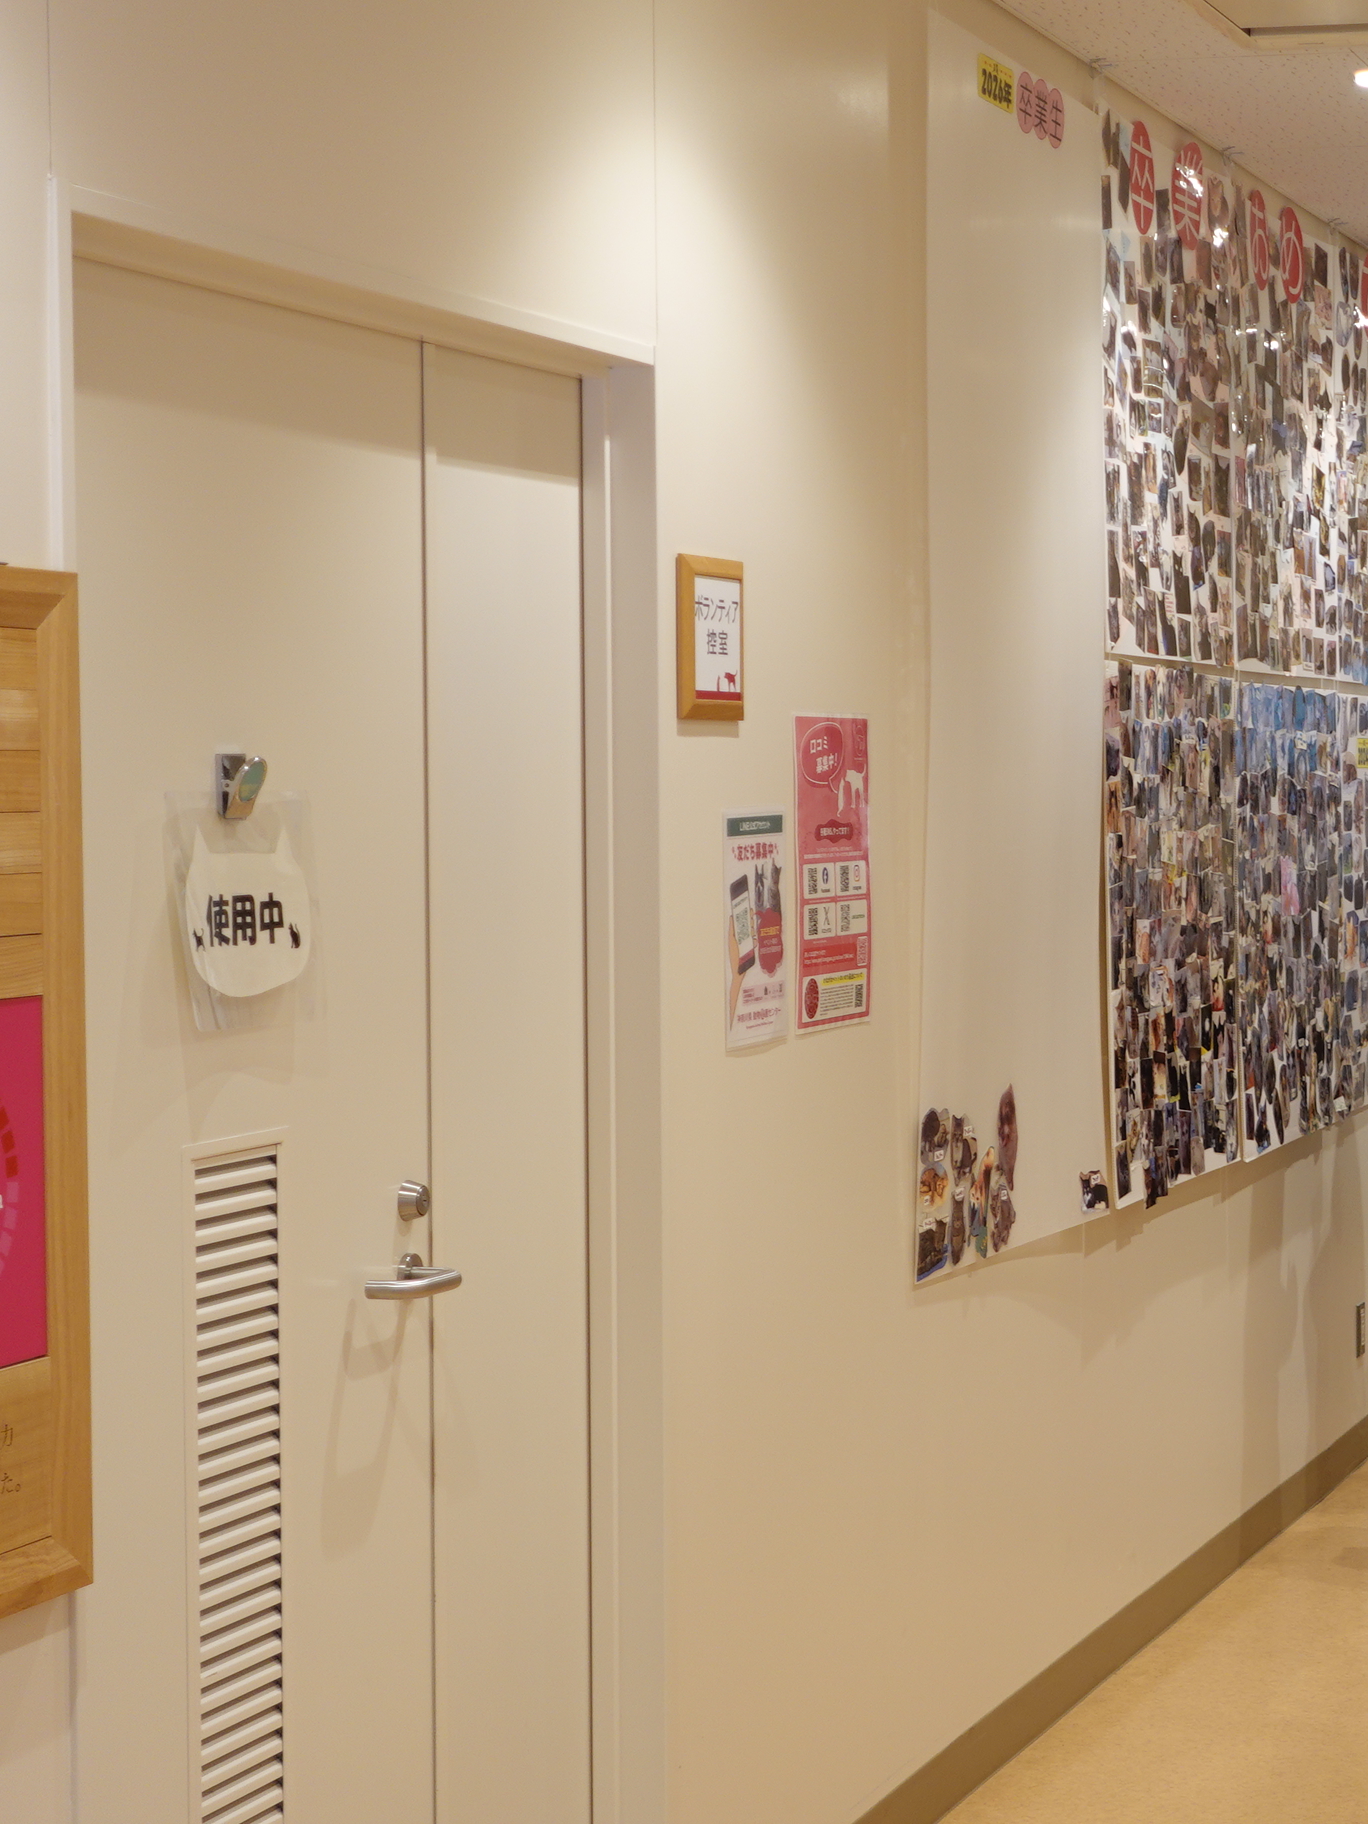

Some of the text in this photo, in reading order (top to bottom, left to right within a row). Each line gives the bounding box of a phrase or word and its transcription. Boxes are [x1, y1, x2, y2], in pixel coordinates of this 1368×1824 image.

[1019, 82, 1062, 142] 卒業生
[694, 594, 739, 624] ボランティア
[706, 628, 729, 656] 控室
[809, 735, 829, 754] 口コミ
[737, 842, 774, 861] 友だち募集中
[206, 892, 284, 947] 使用中
